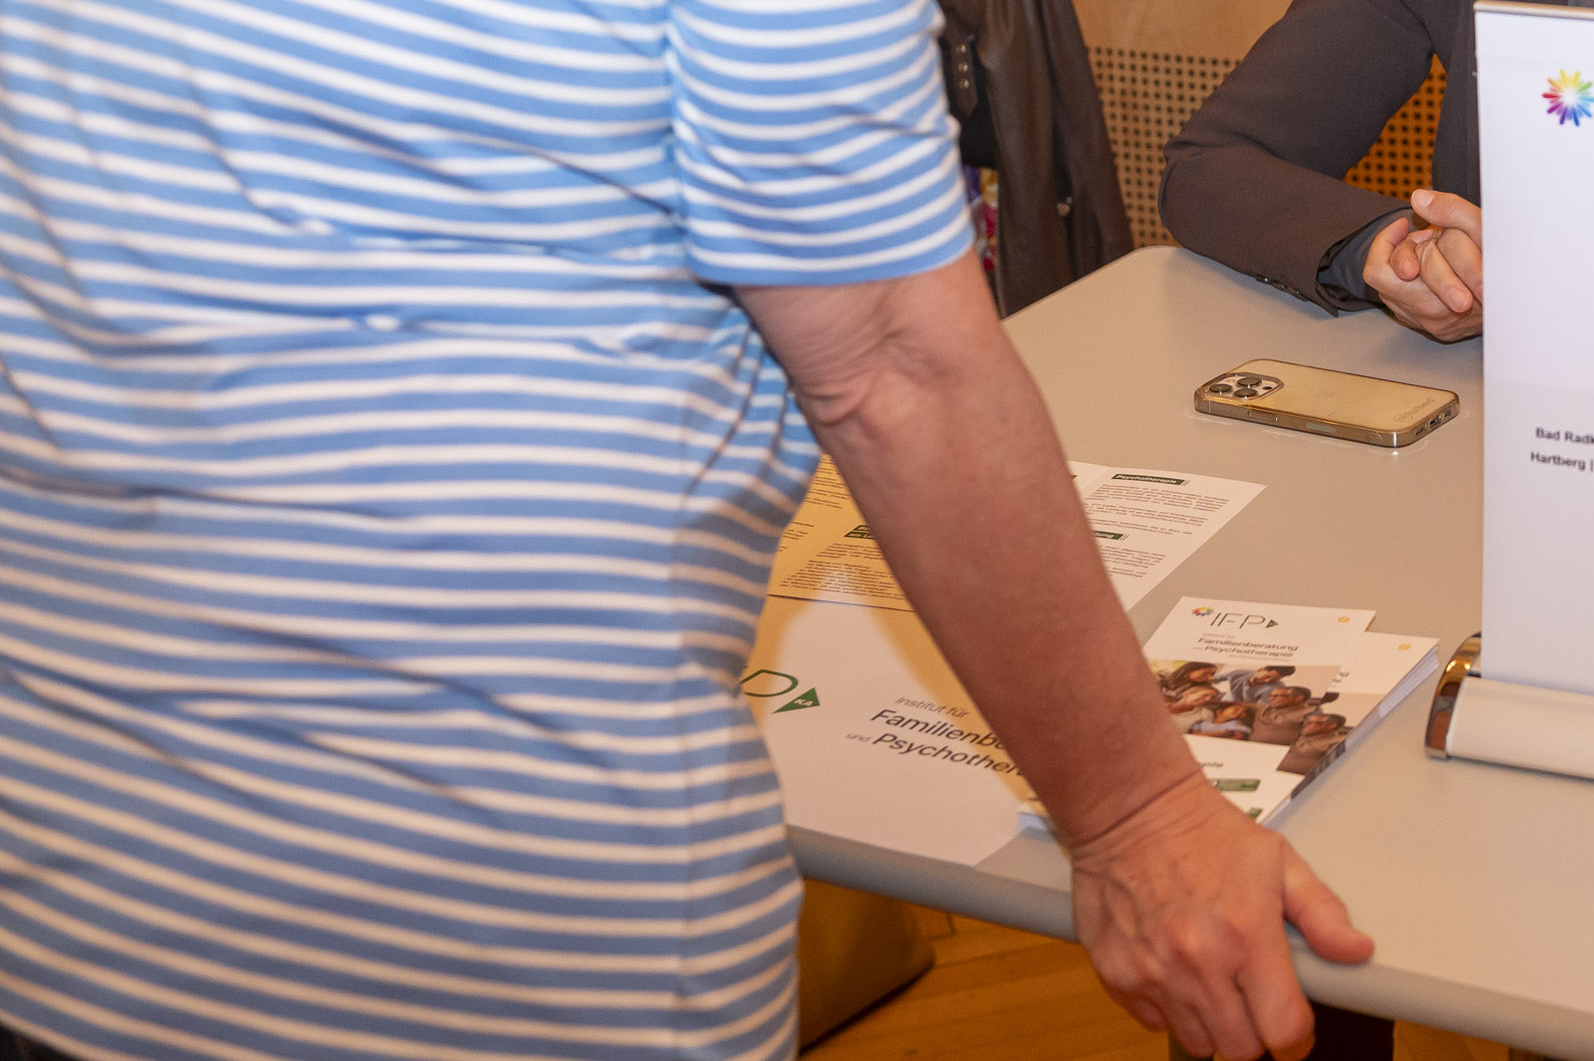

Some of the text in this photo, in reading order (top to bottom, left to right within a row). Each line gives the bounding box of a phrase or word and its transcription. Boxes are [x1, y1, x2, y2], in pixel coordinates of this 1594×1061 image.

[1535, 427, 1560, 441] Bad
[1530, 451, 1586, 471] Hartberg
[1115, 474, 1177, 484] Psychotherapie
[1210, 612, 1266, 629] IFP
[1198, 636, 1298, 652] Familienberatung
[1204, 646, 1294, 657] Psychotherapie
[895, 696, 970, 719] Institut für
[846, 732, 871, 744] und
